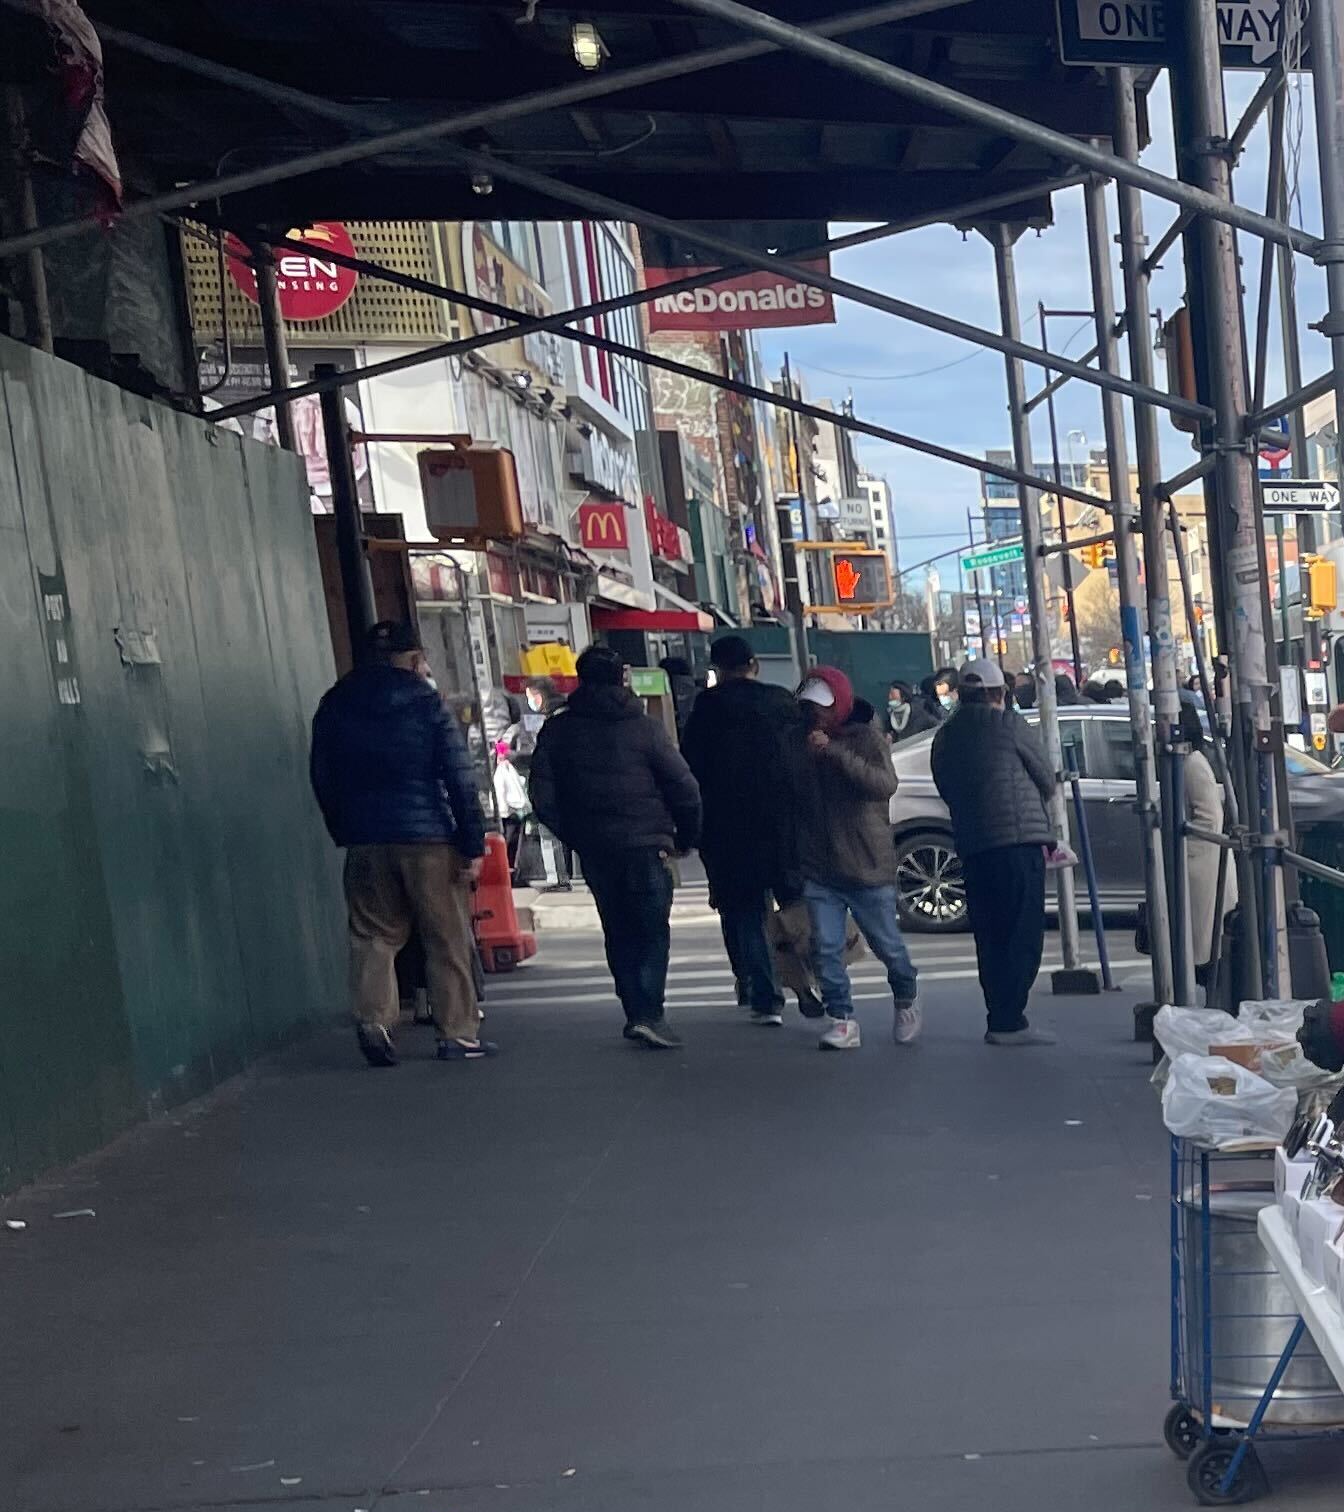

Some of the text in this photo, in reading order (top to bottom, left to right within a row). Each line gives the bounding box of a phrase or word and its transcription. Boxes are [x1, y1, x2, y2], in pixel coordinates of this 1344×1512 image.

[1100, 3, 1164, 37] ONE
[253, 256, 338, 279] EN
[1271, 490, 1337, 503] ONE WAY
